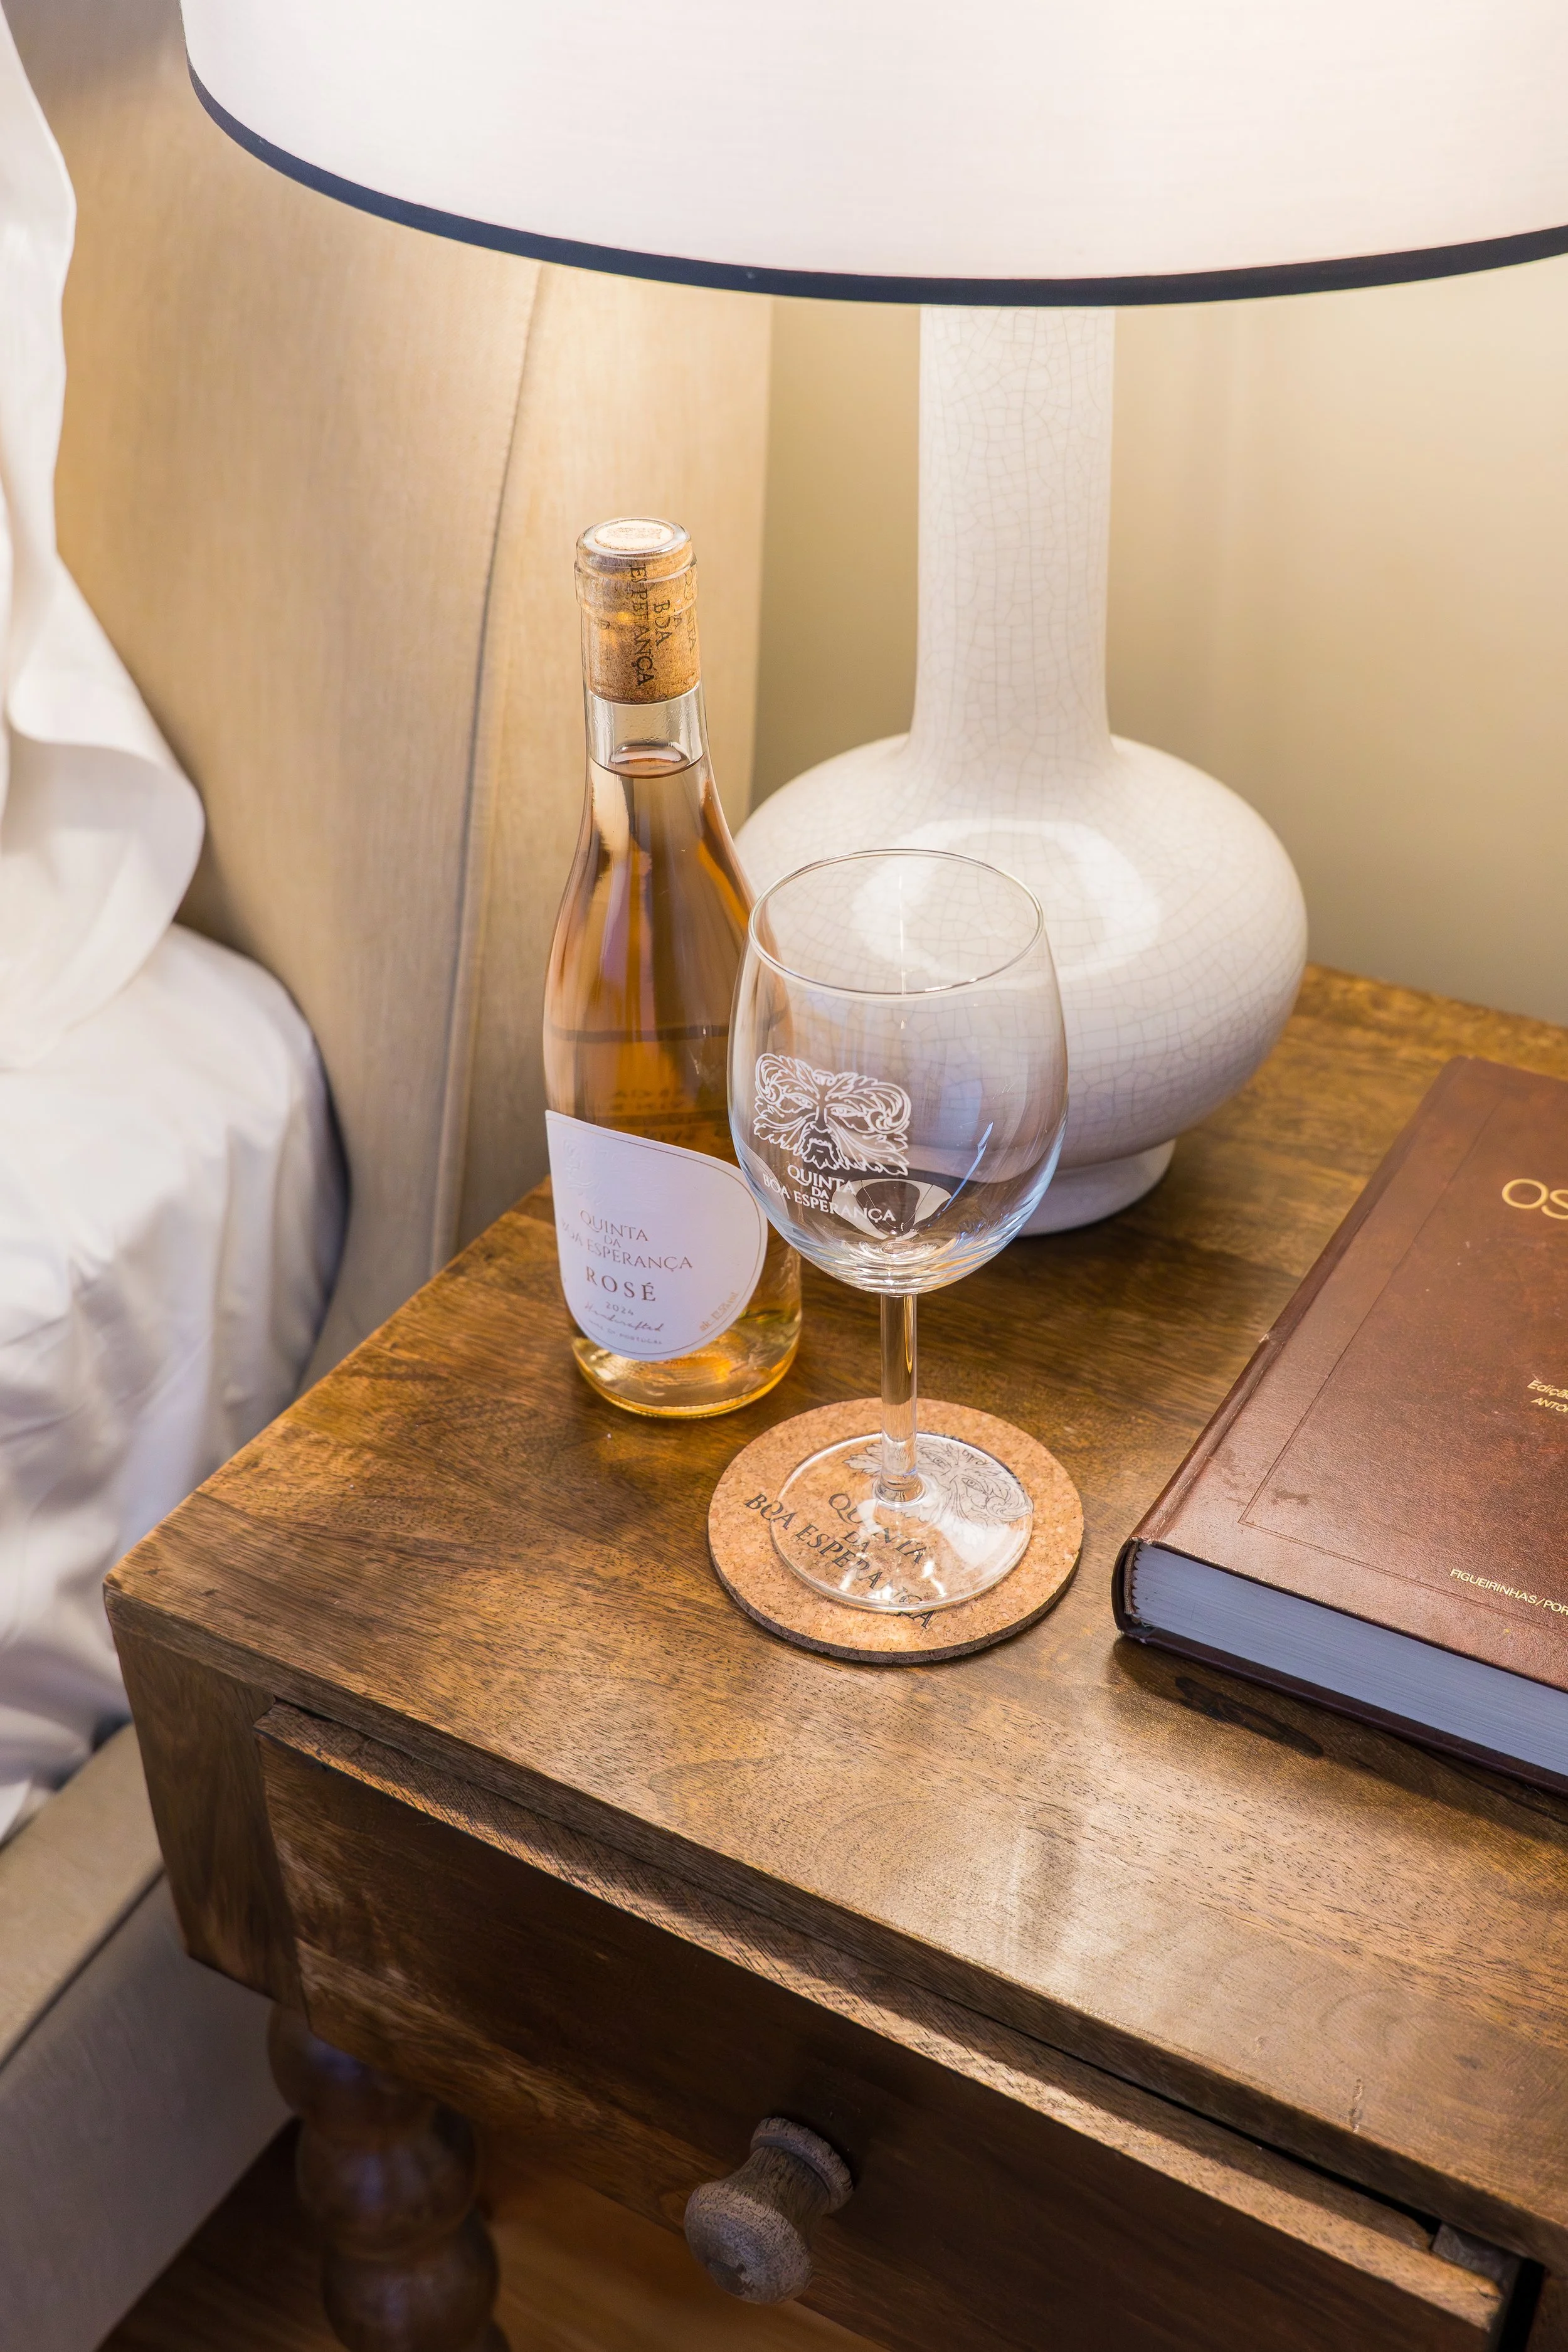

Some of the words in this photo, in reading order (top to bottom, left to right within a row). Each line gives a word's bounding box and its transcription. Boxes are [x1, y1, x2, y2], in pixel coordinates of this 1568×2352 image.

[652, 600, 673, 647] BOA
[787, 1164, 857, 1197] QUINTA
[811, 1186, 830, 1200] DA
[763, 1173, 791, 1200] BOA
[793, 1190, 896, 1223] ESPERANÇA
[580, 1209, 649, 1241] QUINTA
[604, 1234, 621, 1248] DA
[587, 1239, 692, 1273] ESPERANÇA
[586, 1265, 656, 1301] ROSÉ
[744, 1493, 798, 1530] BOA
